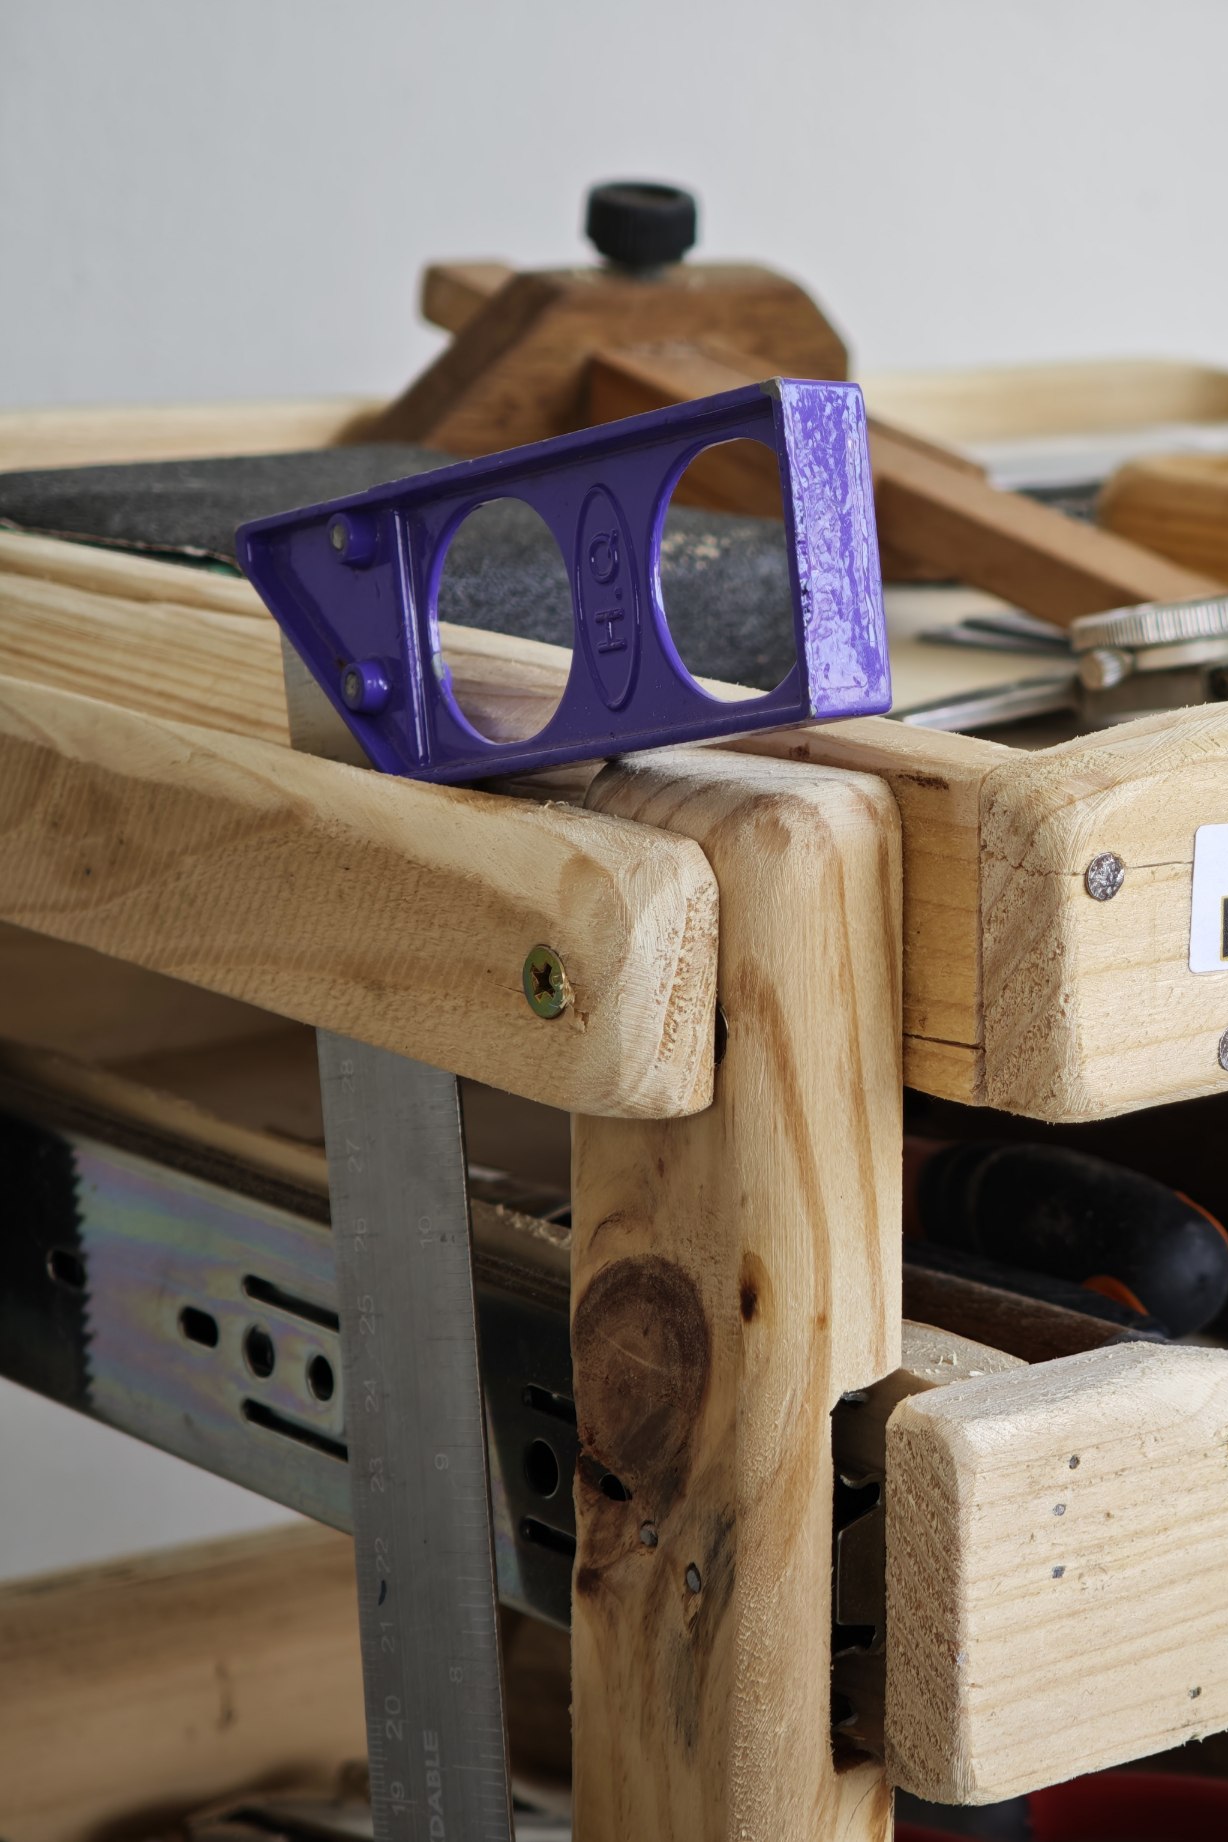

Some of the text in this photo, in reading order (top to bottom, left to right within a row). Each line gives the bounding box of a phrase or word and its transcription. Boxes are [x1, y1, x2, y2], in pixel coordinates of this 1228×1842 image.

[340, 1059, 406, 1816] 19 20 21 22 23 24 25 26 27 28
[417, 1216, 464, 1685] 8 9 10
[422, 1729, 446, 1842] DABLE
